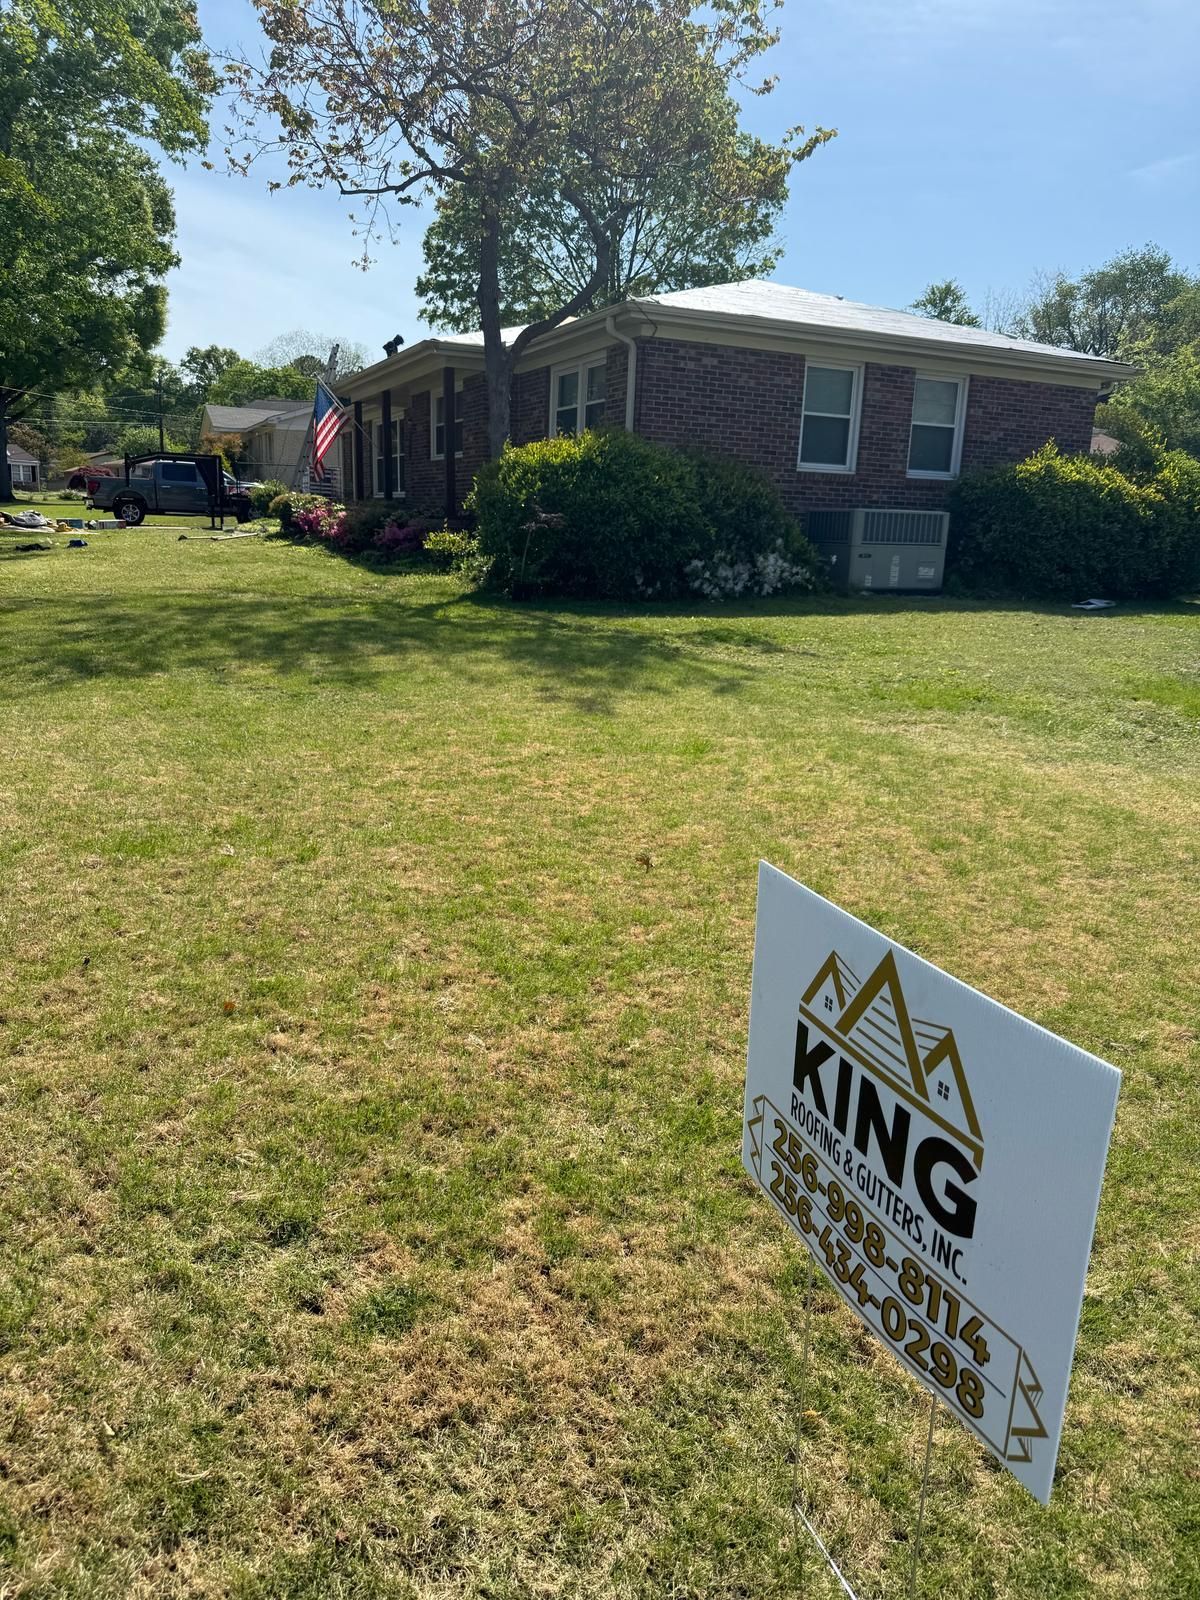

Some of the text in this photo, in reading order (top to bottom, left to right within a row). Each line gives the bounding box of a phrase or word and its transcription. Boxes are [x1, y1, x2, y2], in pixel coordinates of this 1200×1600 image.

[773, 1119, 990, 1366] 256-998-8114
[791, 1092, 967, 1285] ROOFING & GUTTERS, INC.
[793, 1019, 978, 1239] KING
[770, 1160, 985, 1419] 256-434-0298
